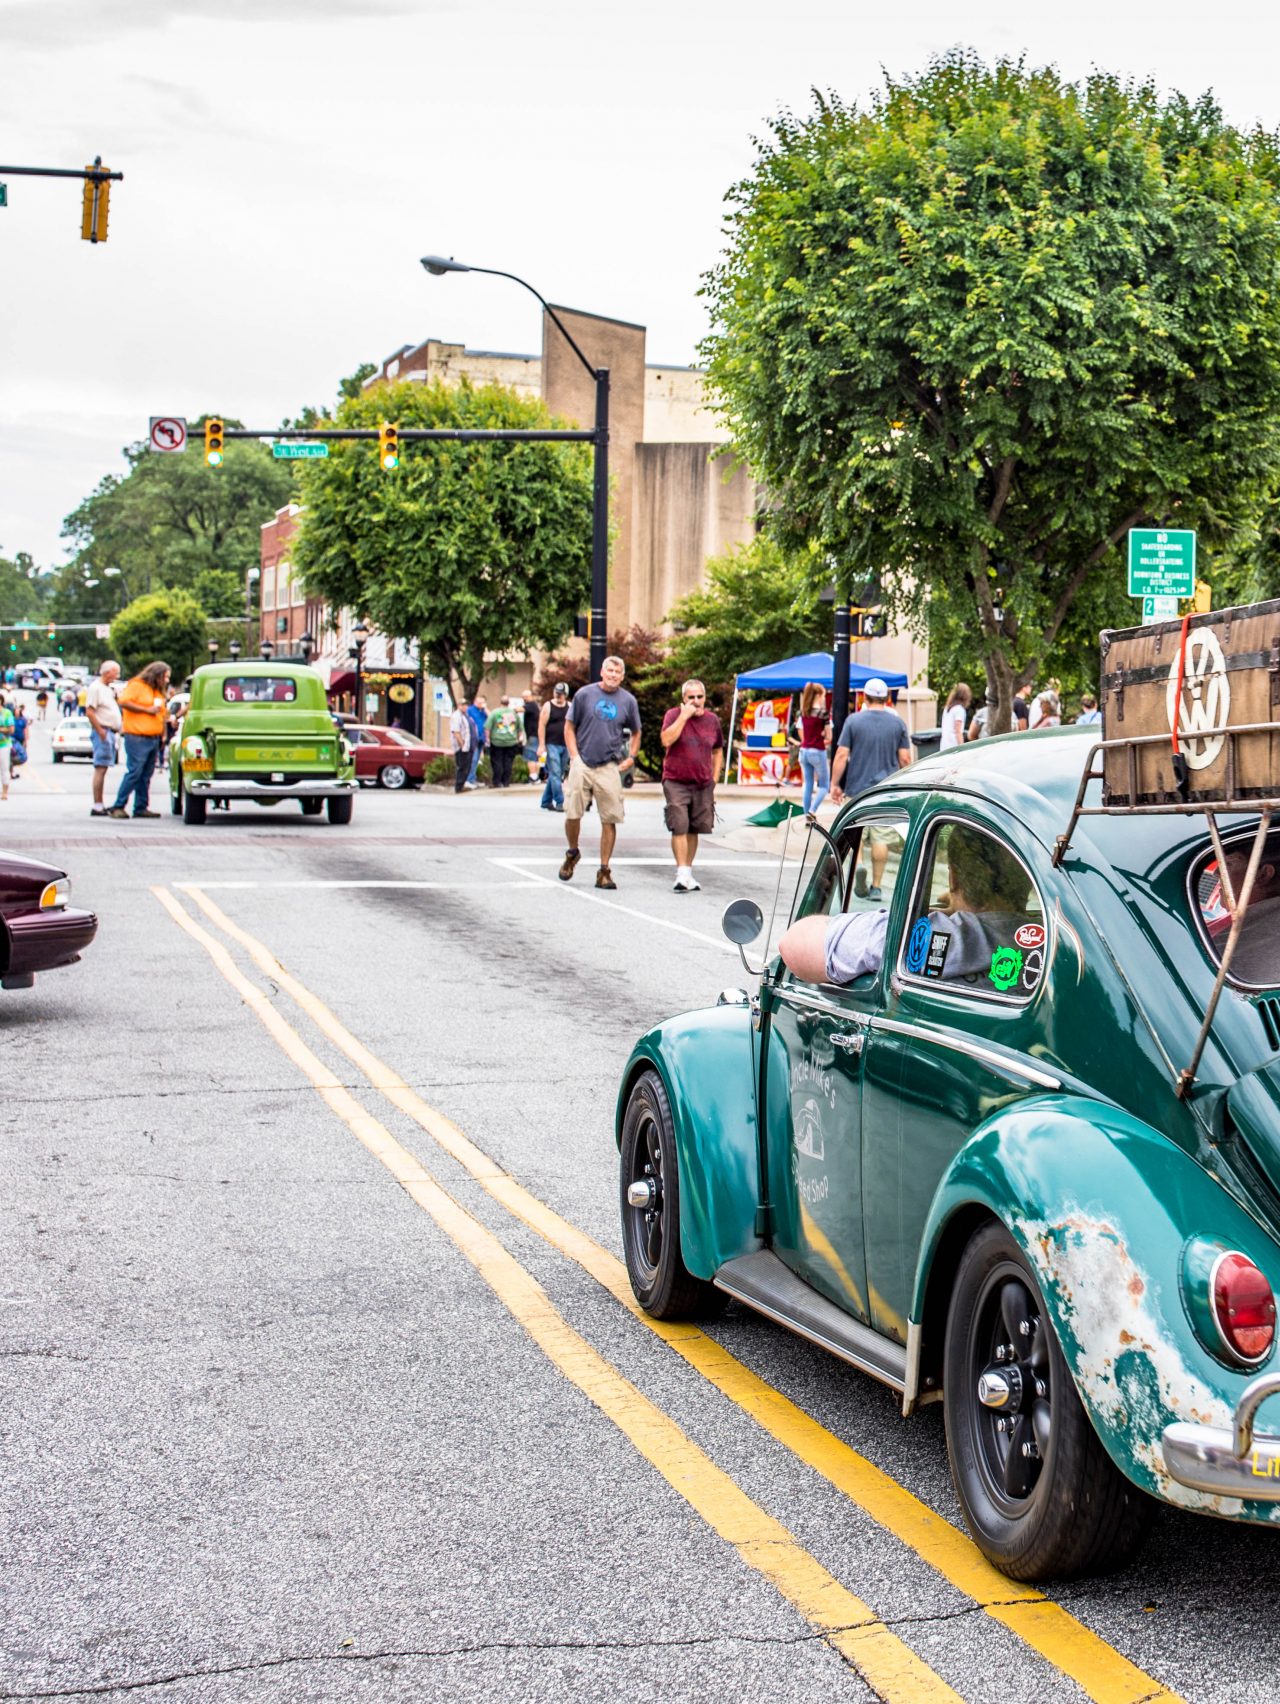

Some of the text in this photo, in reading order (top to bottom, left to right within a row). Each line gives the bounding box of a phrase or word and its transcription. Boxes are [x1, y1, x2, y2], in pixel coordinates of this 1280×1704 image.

[1157, 533, 1168, 543] NO
[1141, 543, 1183, 551] SKATEBOARDING
[1133, 571, 1190, 580] DOWNTOWN BUSINESS
[1145, 600, 1153, 614] 2
